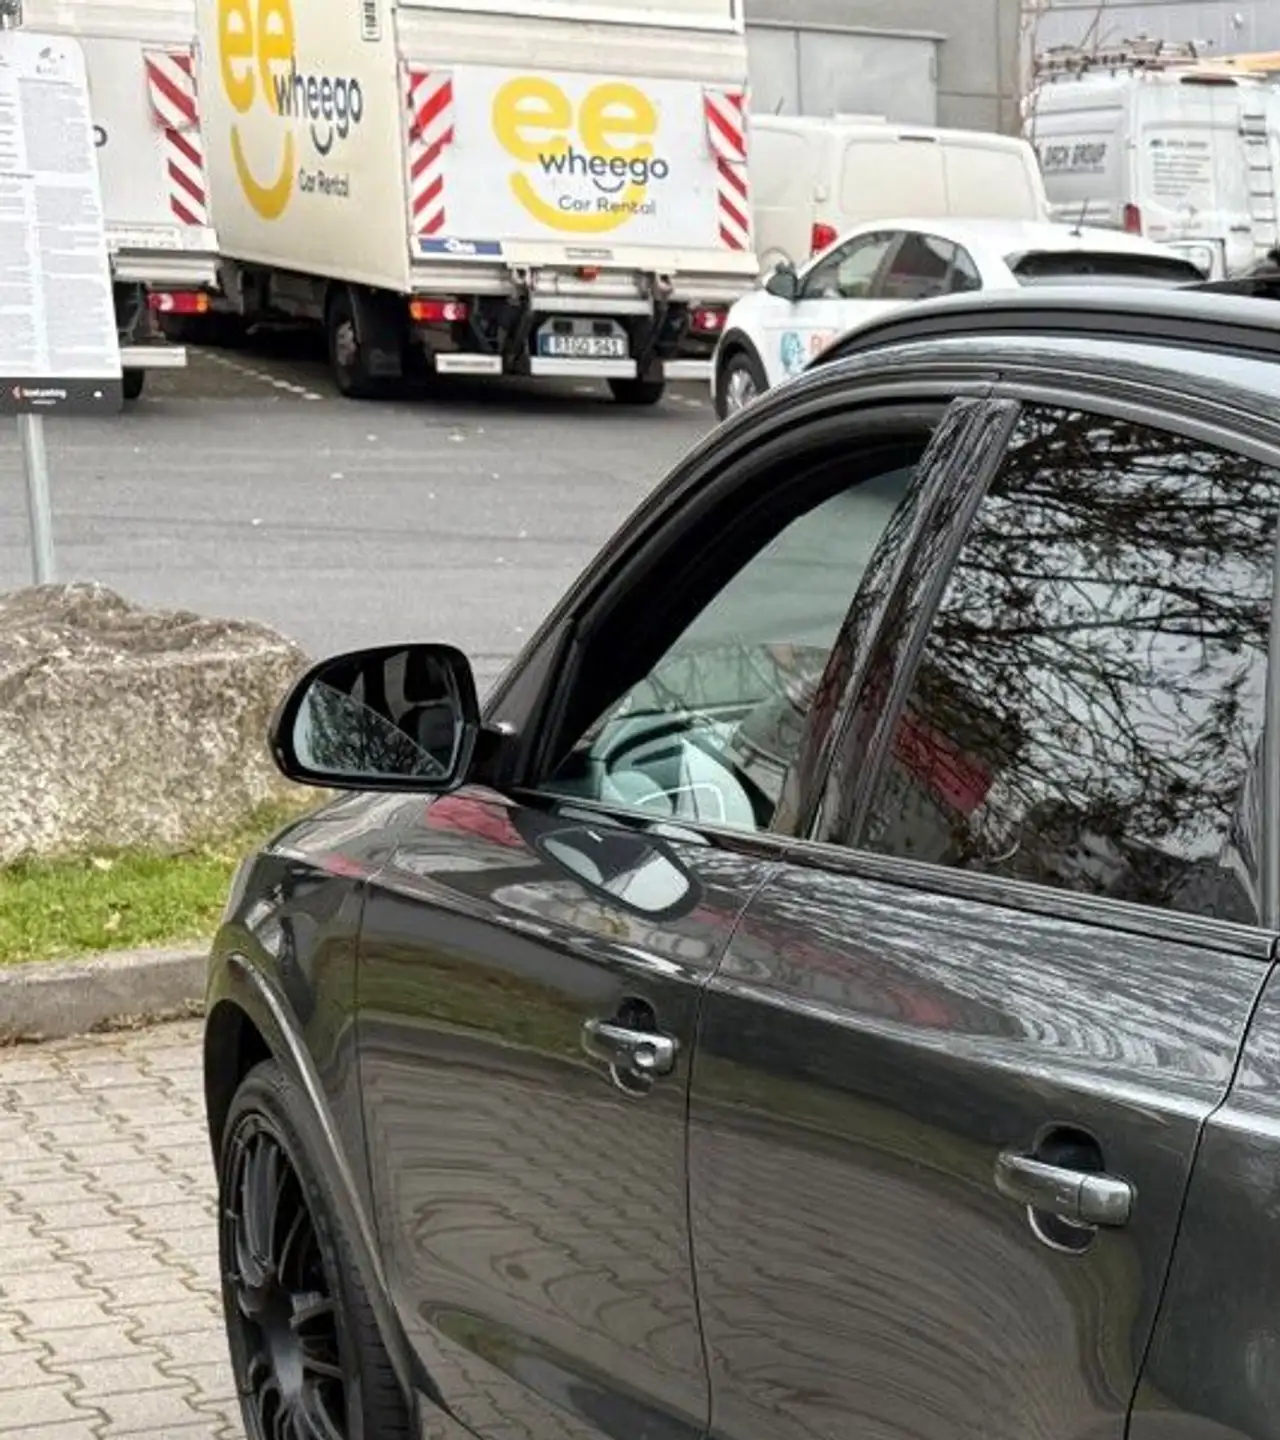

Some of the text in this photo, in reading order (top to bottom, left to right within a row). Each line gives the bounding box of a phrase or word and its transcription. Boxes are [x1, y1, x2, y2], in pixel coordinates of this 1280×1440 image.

[273, 55, 363, 139] wheego
[540, 147, 670, 186] wheego
[559, 194, 657, 216] Car Rental
